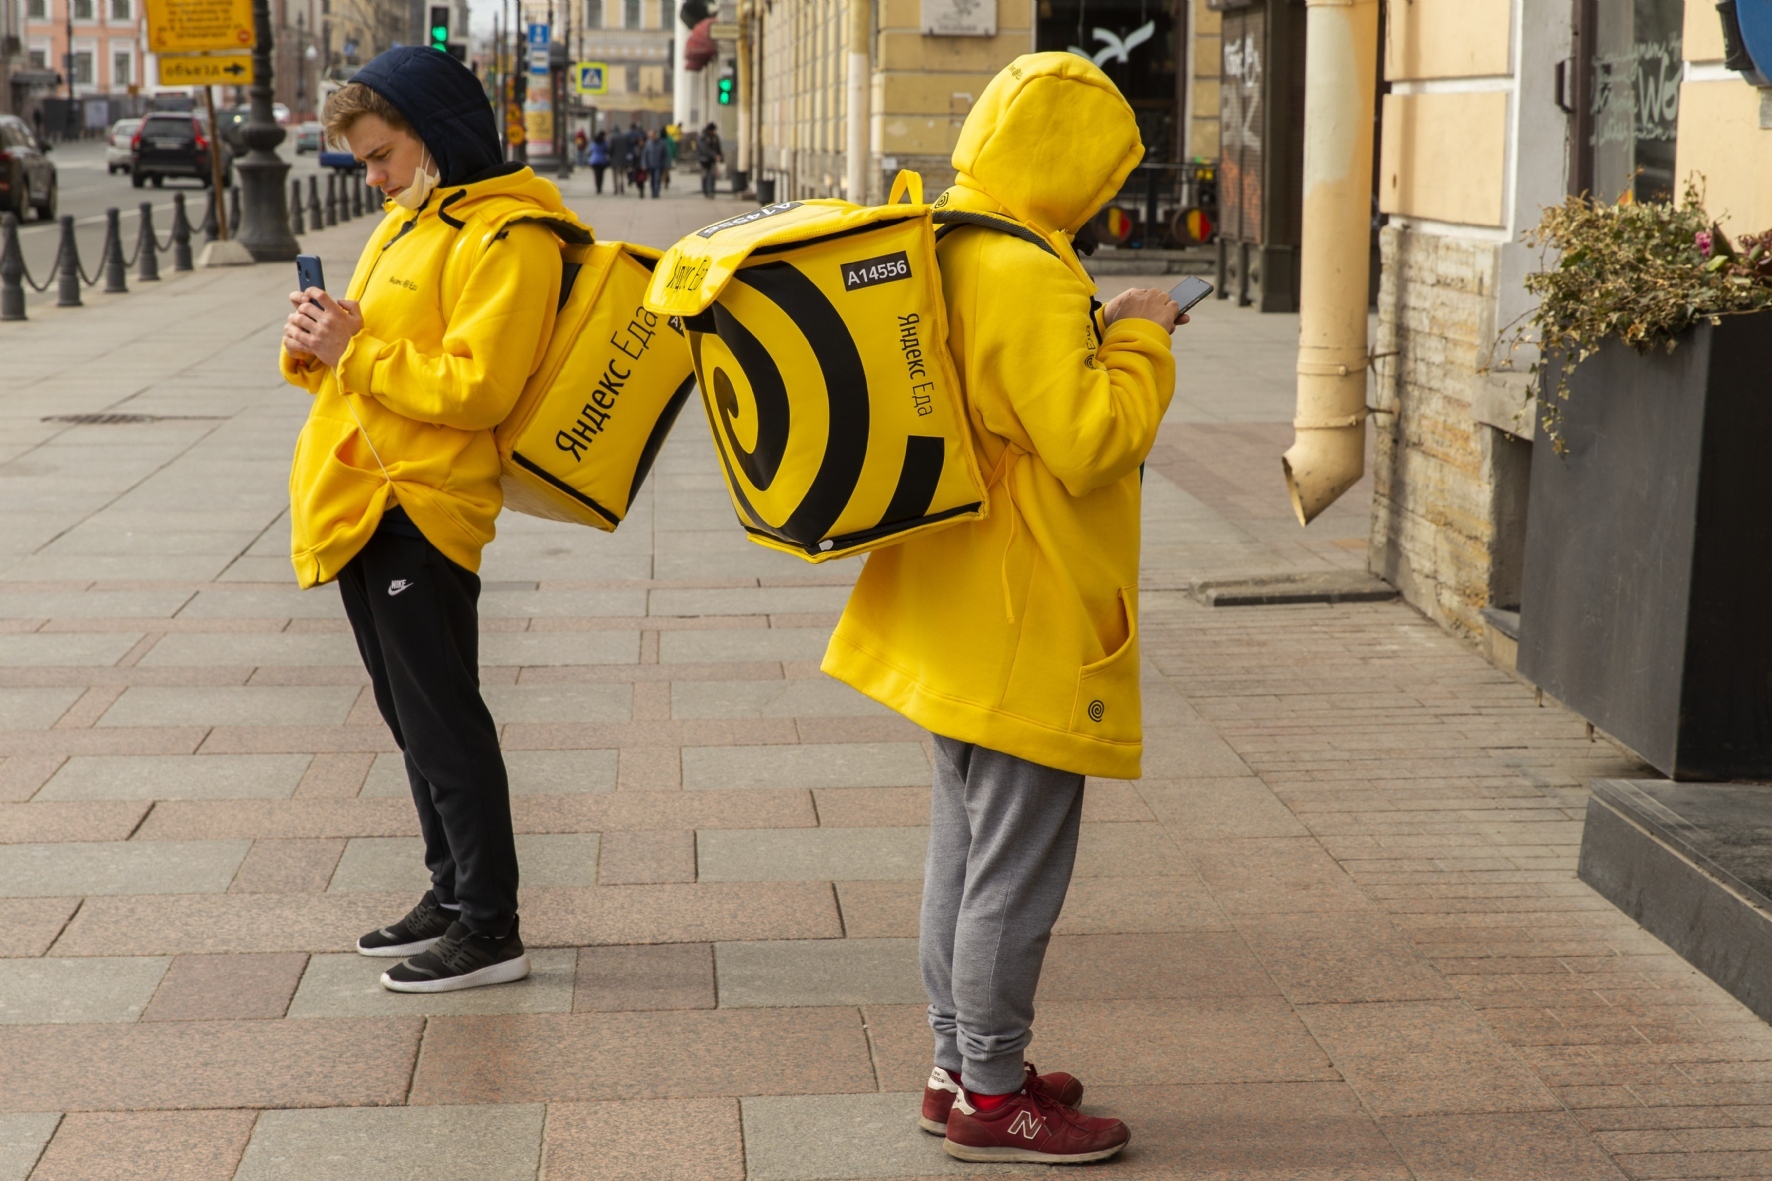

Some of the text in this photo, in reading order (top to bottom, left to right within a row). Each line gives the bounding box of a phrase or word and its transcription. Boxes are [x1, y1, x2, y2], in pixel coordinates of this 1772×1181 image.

[848, 260, 907, 286] A14556
[897, 313, 934, 417] Яндекс Еда
[555, 306, 659, 463] Яндекс Еда
[391, 579, 407, 589] NIKE
[1007, 1109, 1047, 1140] N
